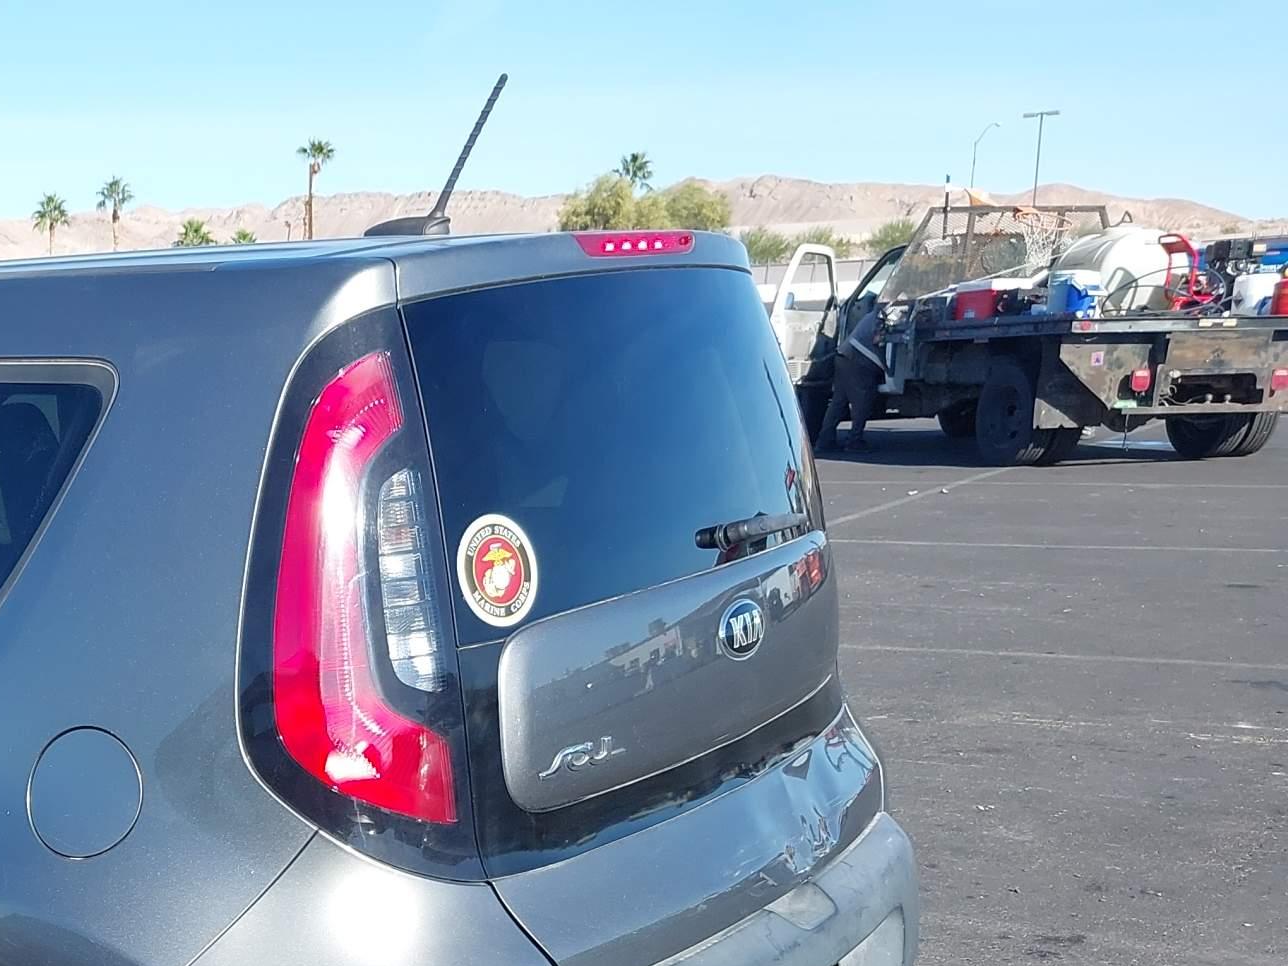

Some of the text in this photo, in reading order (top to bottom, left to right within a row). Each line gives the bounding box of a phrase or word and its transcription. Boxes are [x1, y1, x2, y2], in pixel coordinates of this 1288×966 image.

[467, 525, 521, 556] UNITED STATES
[473, 581, 531, 617] MARINE CORPS
[729, 608, 764, 649] KIA
